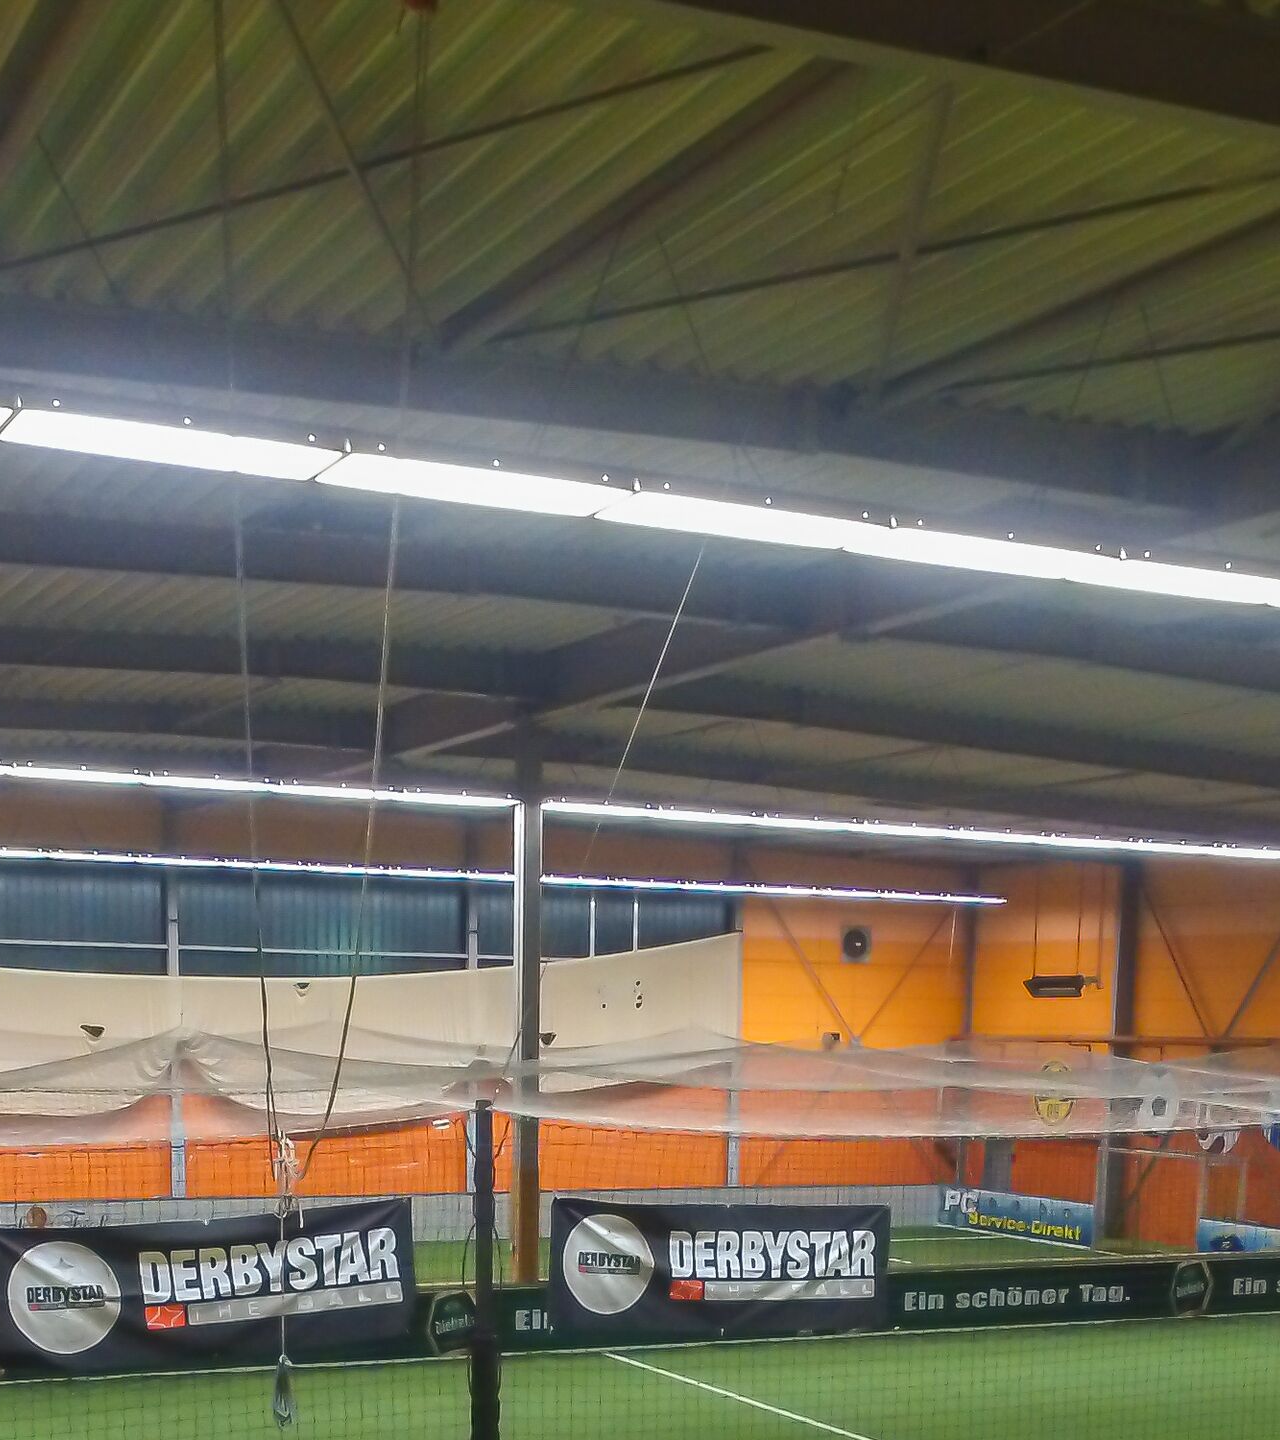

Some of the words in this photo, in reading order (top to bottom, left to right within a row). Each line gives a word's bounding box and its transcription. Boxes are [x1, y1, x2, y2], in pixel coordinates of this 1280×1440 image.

[944, 1189, 979, 1214] PC
[138, 1227, 400, 1304] DERBYSTAR
[578, 1250, 641, 1267] DERBYSTAR
[669, 1230, 876, 1279] DERBYSTAR
[26, 1284, 105, 1304] DERBYSTAR
[903, 1291, 945, 1312] Ein
[955, 1287, 1069, 1309] schöner
[1079, 1283, 1131, 1302] Tag.
[1233, 1277, 1267, 1296] Ein
